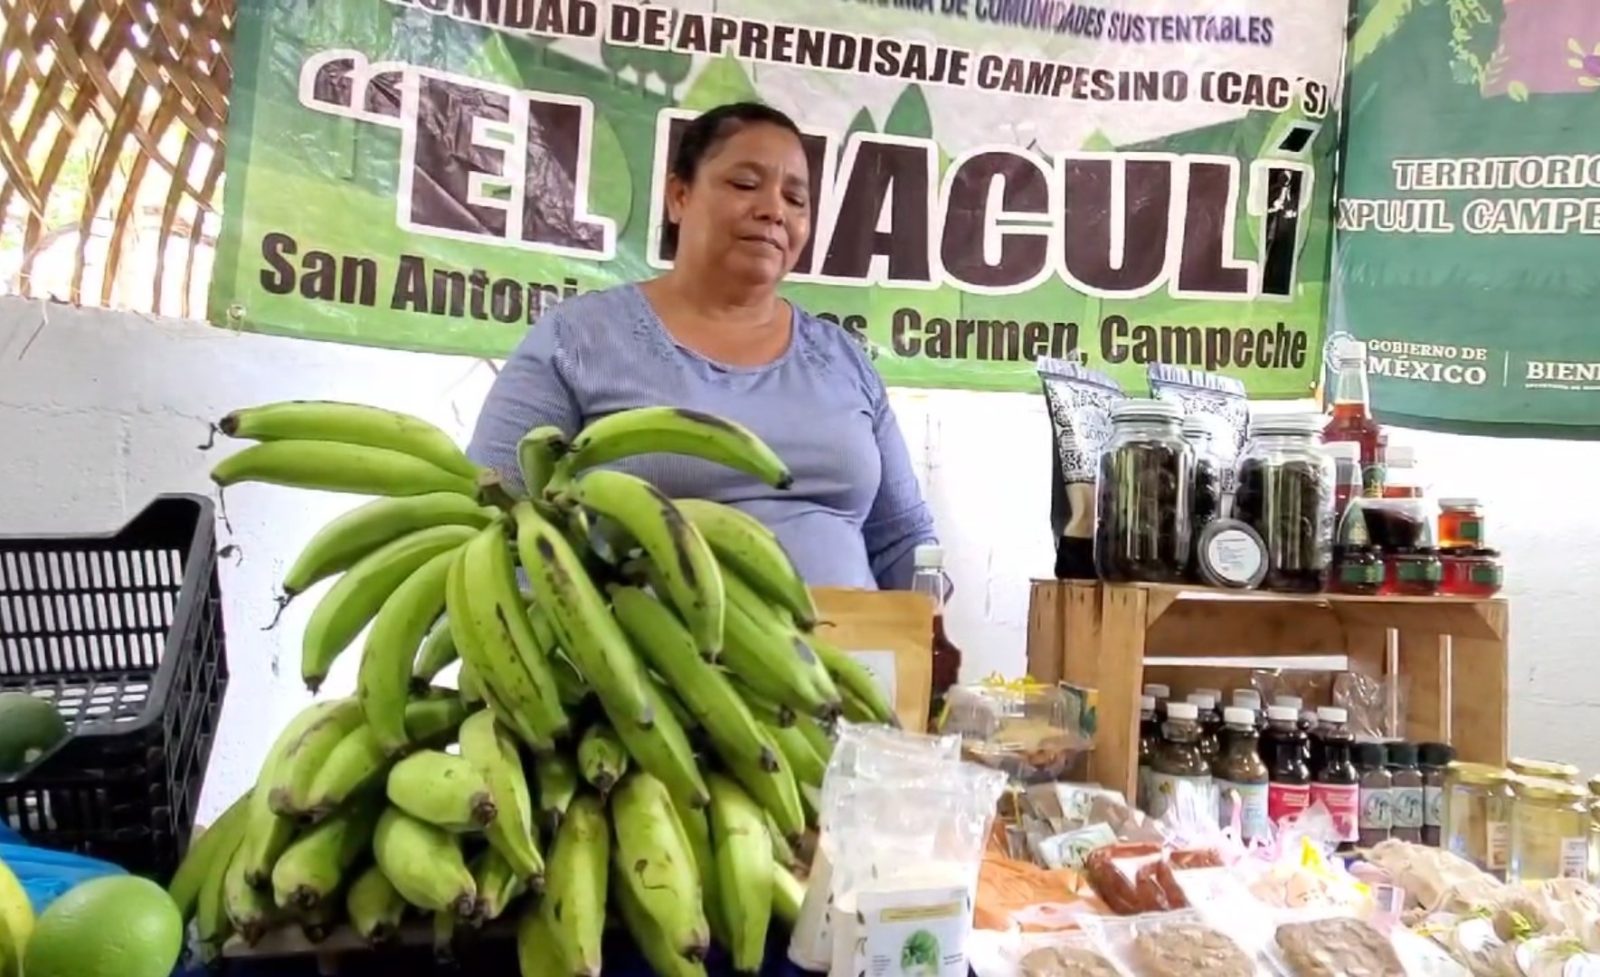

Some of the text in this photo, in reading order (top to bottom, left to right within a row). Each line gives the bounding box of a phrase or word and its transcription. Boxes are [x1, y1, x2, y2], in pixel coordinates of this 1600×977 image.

[975, 0, 1106, 38] COMUNIDADES
[1107, 13, 1275, 46] SUSTENTABLES
[610, 4, 668, 47] DE
[676, 13, 969, 86] APRENDISAJE
[977, 54, 1189, 102] CAMPESINO
[1338, 198, 1455, 233] XPUJIL
[259, 231, 377, 306] San
[891, 307, 1088, 366] Carmen,
[1100, 314, 1308, 372] Campeche
[1367, 338, 1488, 361] GOBIERNO DE
[1366, 355, 1488, 386] MÉXICO
[1525, 360, 1600, 381] BIEN
